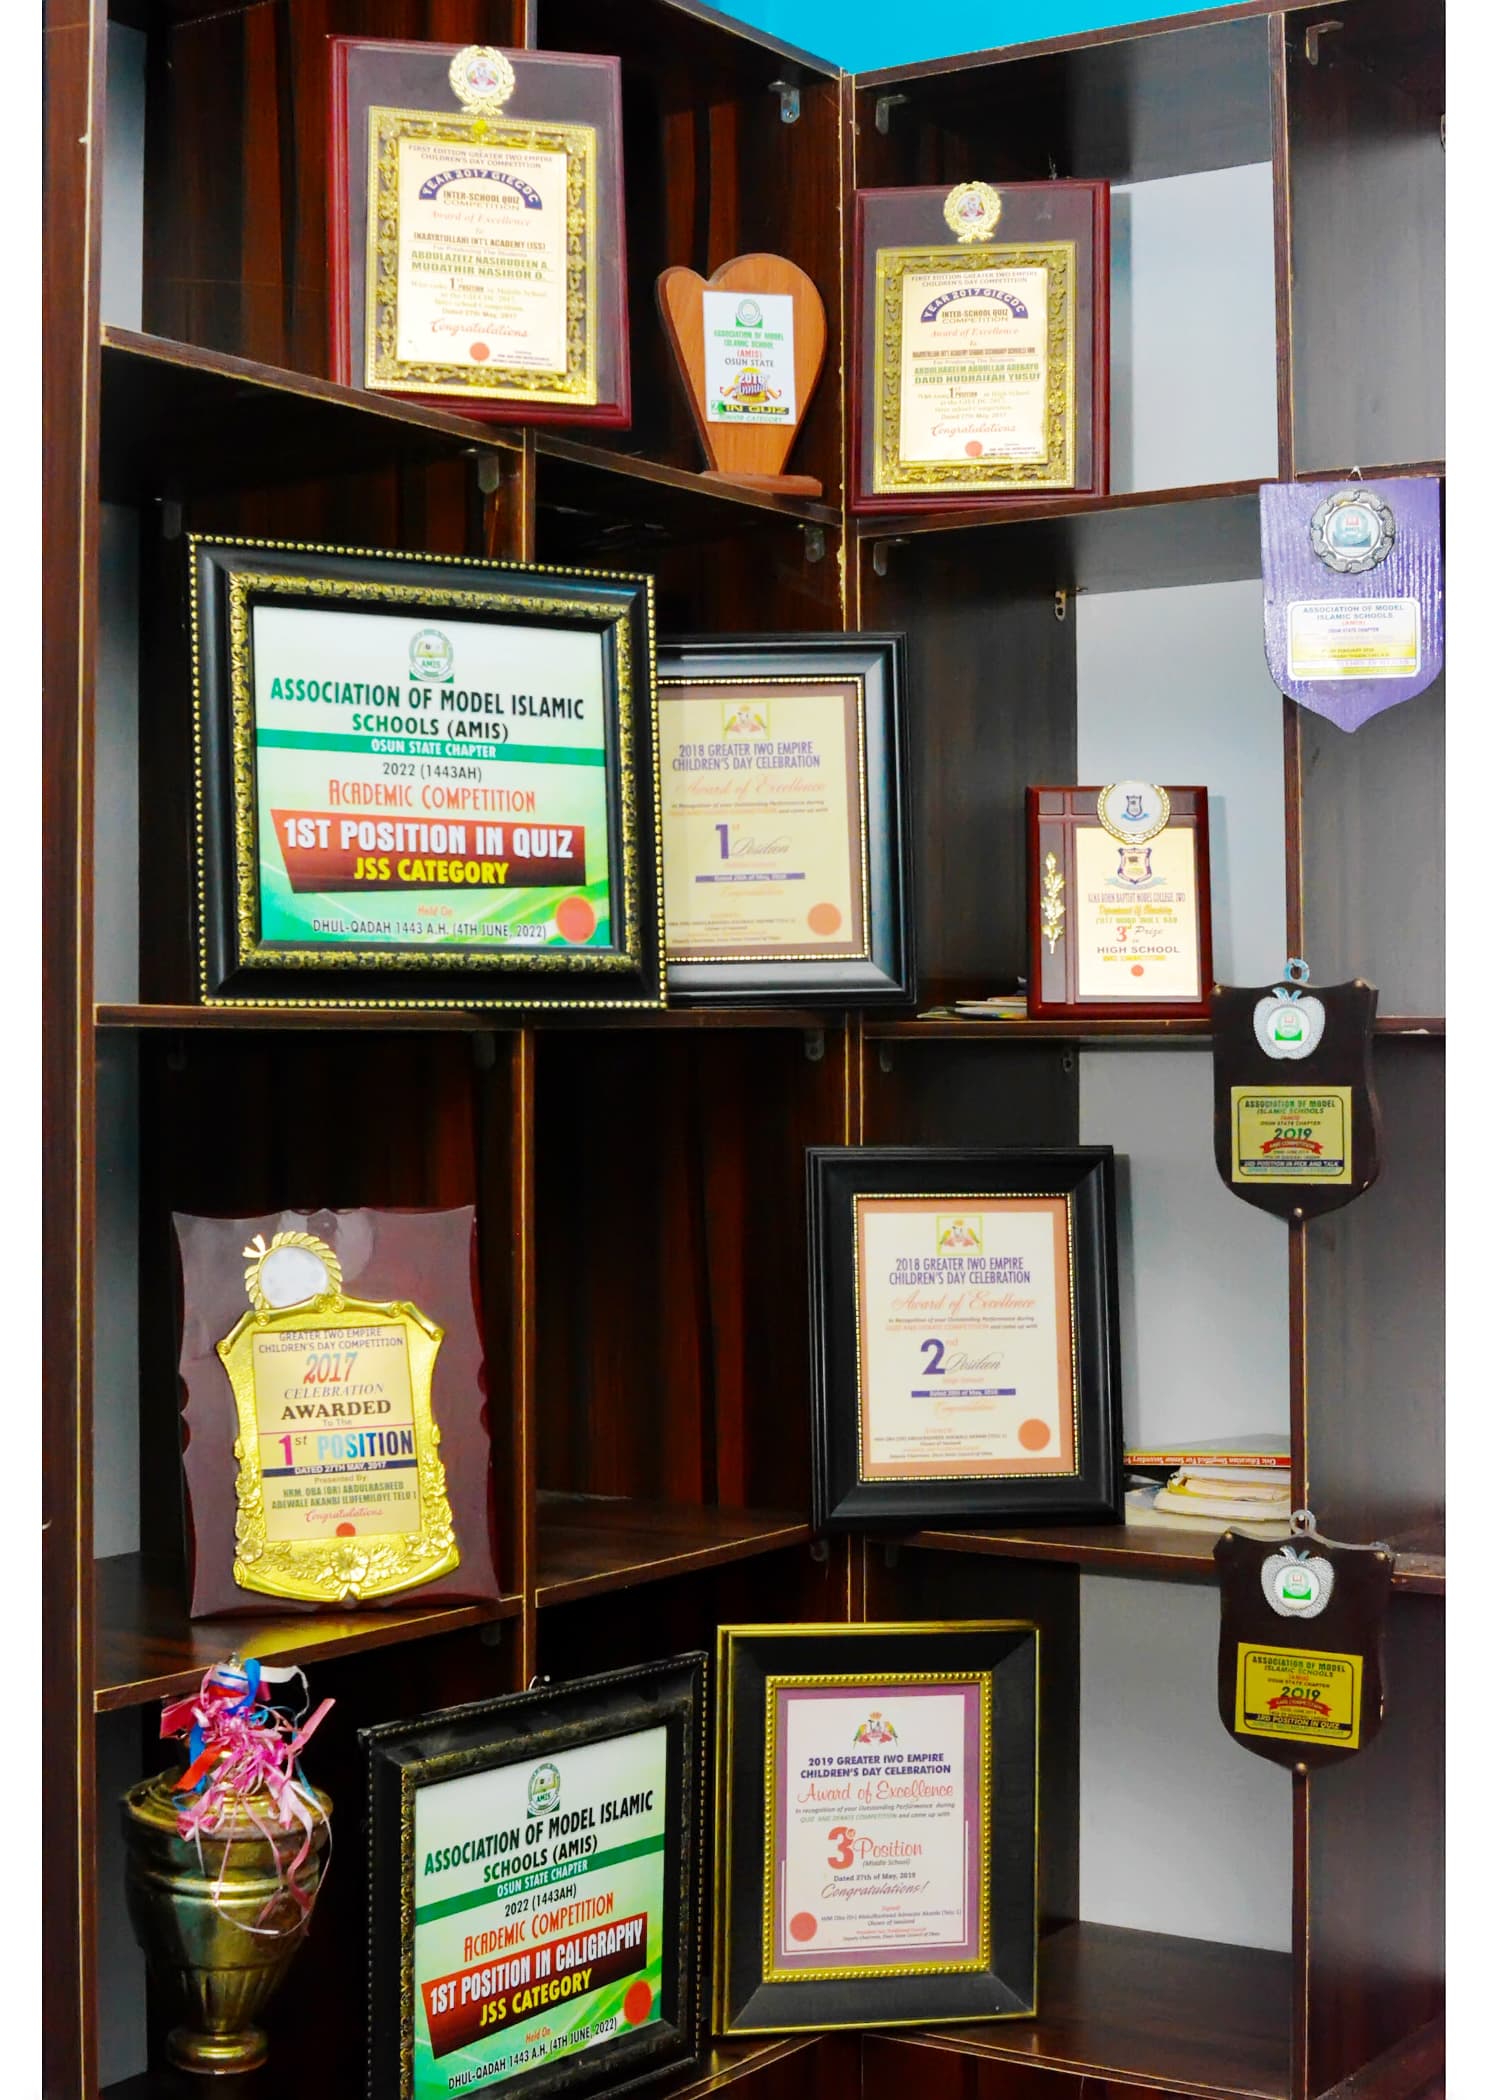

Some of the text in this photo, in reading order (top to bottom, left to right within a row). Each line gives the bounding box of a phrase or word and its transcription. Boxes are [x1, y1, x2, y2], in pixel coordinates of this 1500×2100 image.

[422, 172, 453, 195] YEAR
[924, 296, 951, 318] YEAR
[952, 288, 982, 300] 2017
[725, 357, 748, 366] OSUN
[1303, 606, 1359, 614] ASSOCIATION
[270, 677, 585, 720] ASSOCIATION OF MODEL ISLAMIC
[351, 713, 509, 743] SCHOOLS (AMIS)
[370, 738, 497, 759] OSUN STATE CHAPTER
[679, 743, 704, 758] 2018
[707, 743, 751, 757] GREATER
[776, 741, 813, 755] EMPIRE
[382, 762, 482, 783] 2022 (1443AH)
[671, 755, 821, 772] CHILDREN'S DAY CELEBRATION
[328, 779, 536, 813] ACADEMIC COMPETITION
[284, 818, 575, 859] 1ST POSITION IN QUIZ
[353, 857, 510, 885] JSS CATEGORY
[417, 905, 440, 917] Held
[312, 919, 547, 940] DHUL-QADAH 1443 A.H. (4TH JUNE, 2022)
[1245, 1100, 1335, 1108] ASSOCIATION MODEL
[1274, 1127, 1313, 1140] 2019
[895, 1257, 920, 1272] 2018
[923, 1257, 964, 1272] GREATER
[989, 1256, 1024, 1270] EMPIRE
[889, 1270, 1031, 1286] CHILDREN'S DAY CELEBRATION
[891, 1287, 1036, 1317] Award of Excellence
[279, 1330, 322, 1342] GREATER
[347, 1327, 382, 1339] EMPIRE
[258, 1337, 404, 1354] CHILDREN'S DAY COMPETITION
[303, 1351, 359, 1385] 2017
[284, 1382, 385, 1401] CELEBRATION
[281, 1399, 392, 1421] AWARDED
[317, 1430, 414, 1461] POSITION
[294, 1465, 324, 1475] DATED
[325, 1464, 346, 1474] 27TH
[1228, 1456, 1260, 1466] Education
[313, 1474, 354, 1485] Presented
[1252, 1656, 1345, 1673] ASSOCIATION OF MODEL
[1264, 1665, 1294, 1675] ISLAMIC
[1298, 1669, 1334, 1678] SCHOOLS
[1280, 1685, 1321, 1700] 2019
[1272, 1716, 1309, 1726] POSITION
[1320, 1721, 1341, 1729] QUIZ
[808, 1753, 944, 1767] 2019 GREATER IWO EMPIRE
[800, 1764, 952, 1779] CHILDREN'S DAY CELEBRATION
[797, 1779, 954, 1804] Award of Excellence
[423, 1790, 654, 1877] ASSOCIATION OF MODEL ISLAMIC
[853, 1836, 923, 1860] Position
[483, 1834, 598, 1884] SCHOOLS (AMIS)
[496, 1859, 589, 1898] OSUN STATE CHAPTER
[833, 1874, 855, 1882] Dated
[873, 1873, 881, 1881] of
[504, 1883, 577, 1918] 2022 (1443AH)
[820, 1880, 931, 1902] Congratulations!
[464, 1891, 614, 1963] ACADEMIC COMPETITION
[430, 1918, 643, 2016] 1ST POSITION IN CALIGRAPHY
[480, 1967, 593, 2027] JSS CATEGORY
[526, 2031, 541, 2044] Held
[448, 2061, 506, 2090] DHUL-QADAH
[510, 2052, 529, 2067] 1443
[532, 2046, 548, 2060] A.H.
[549, 2035, 569, 2054] (4TH
[595, 2017, 618, 2036] 2022)
